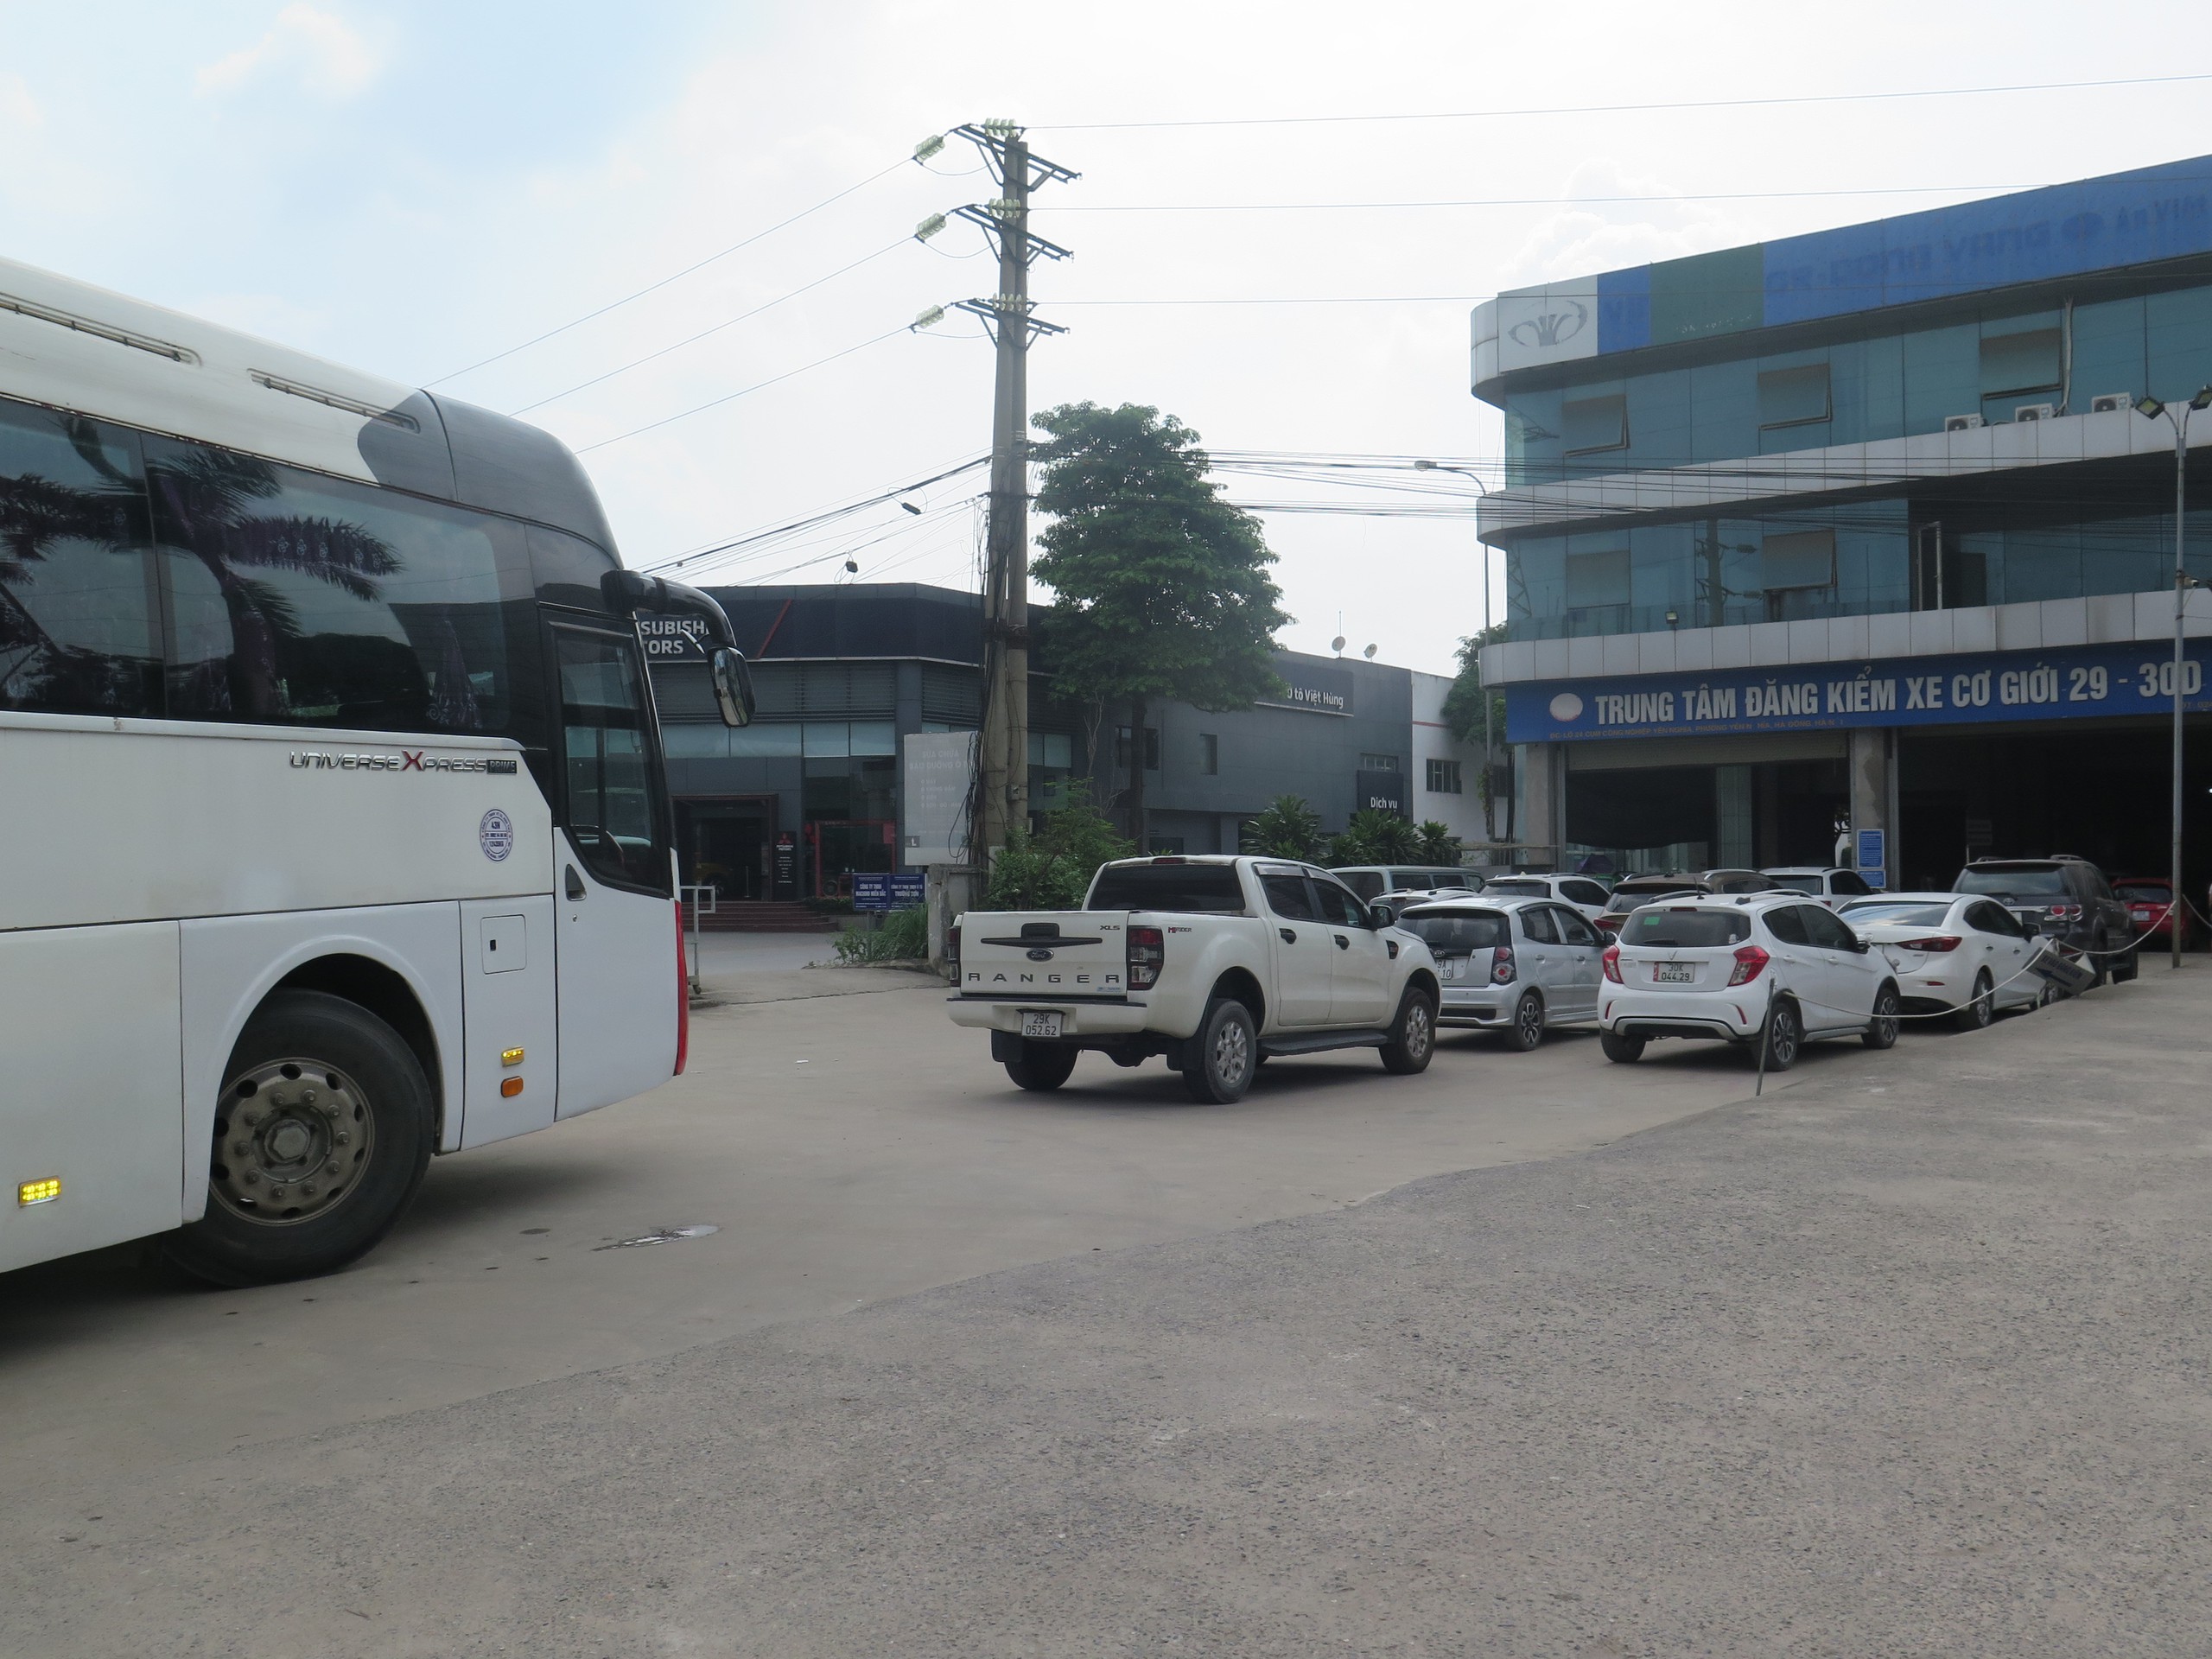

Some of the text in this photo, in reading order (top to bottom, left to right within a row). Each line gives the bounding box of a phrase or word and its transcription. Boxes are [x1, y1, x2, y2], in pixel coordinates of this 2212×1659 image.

[640, 620, 709, 635] SUBISH
[1305, 689, 1321, 706] Việt
[1323, 692, 1344, 709] Hùng
[1594, 690, 1675, 727] TRUNG
[1681, 683, 1736, 721] TÂM
[1745, 678, 1818, 717] ĐĂNG
[1827, 664, 1896, 714] KIỂM
[1905, 676, 1943, 710] XE
[1952, 670, 1992, 708] CƠ
[1999, 661, 2058, 705] GIỚI
[2069, 665, 2107, 702] 29
[489, 760, 516, 773] PRIME
[1370, 797, 1397, 811] Dịch vụ
[1437, 960, 1446, 969] 9A
[1669, 963, 1684, 972] 30K
[968, 972, 1120, 983] RANGER
[1442, 969, 1452, 978] 10
[1661, 973, 1690, 982] 044.29
[1033, 1014, 1050, 1025] 29K
[1026, 1025, 1057, 1036] 052.62
